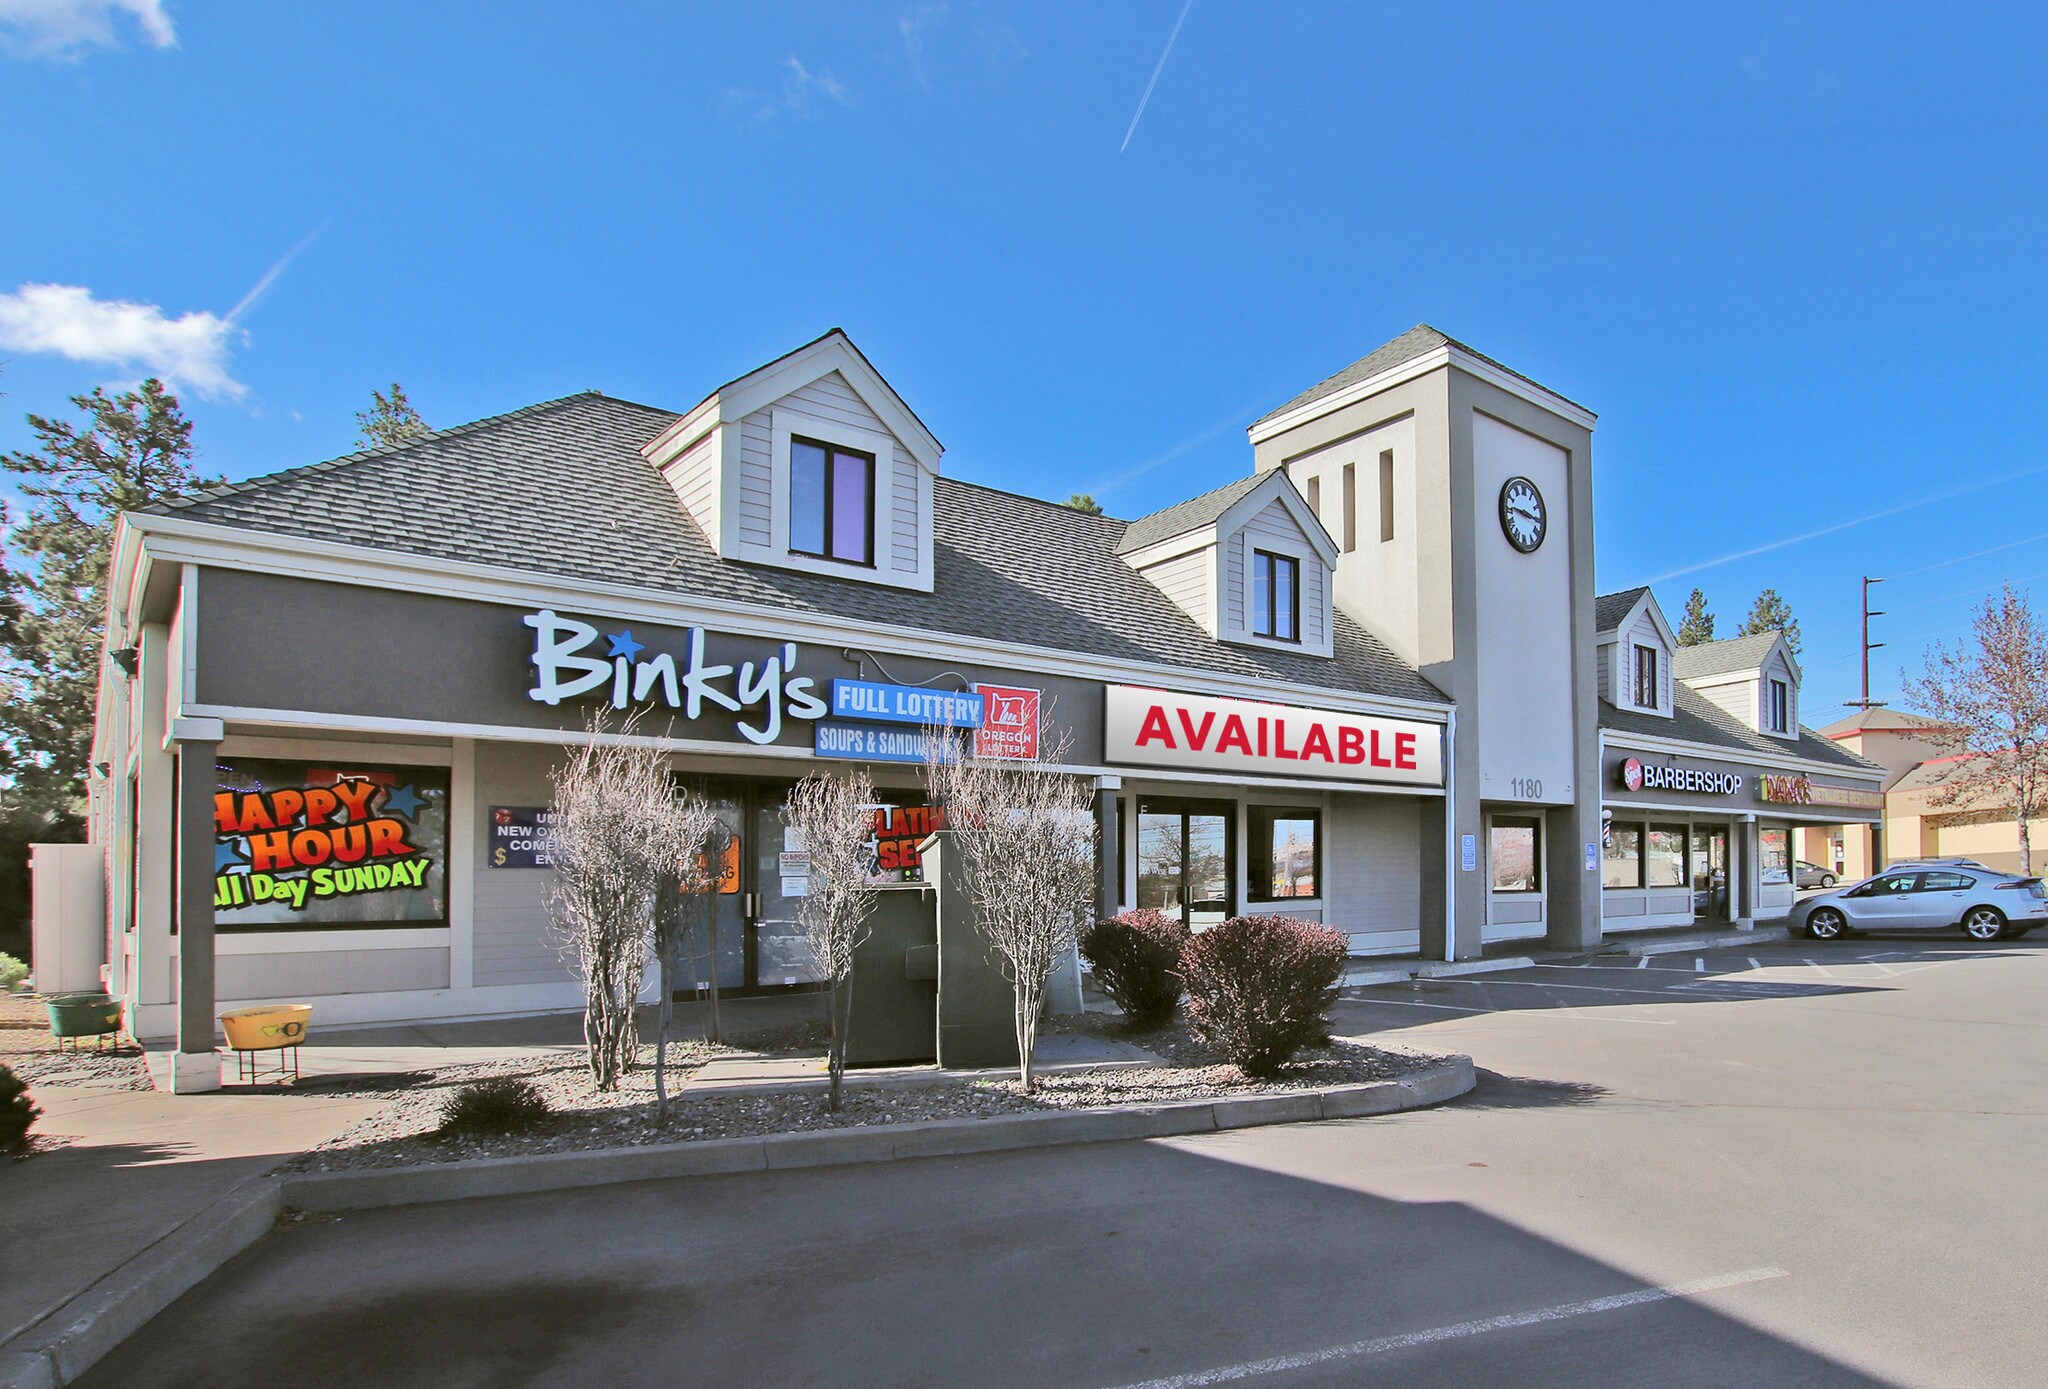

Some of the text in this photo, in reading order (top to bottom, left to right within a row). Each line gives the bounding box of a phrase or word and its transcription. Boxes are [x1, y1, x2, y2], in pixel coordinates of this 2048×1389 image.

[523, 609, 828, 745] Binky's
[838, 685, 980, 722] FULL LOTTERY
[819, 727, 960, 761] SOUPS & SANDW
[982, 730, 1031, 743] OREGON
[1134, 705, 1417, 770] AVAILABLE
[216, 771, 255, 787] PEN
[1511, 777, 1543, 799] 1180
[1644, 765, 1742, 794] BARBERSHOP
[214, 781, 376, 832] HAPPY
[249, 819, 416, 872] HOUR
[497, 826, 532, 836] NEW
[510, 840, 554, 850] COME
[214, 858, 429, 907] ll Day SUNDAY
